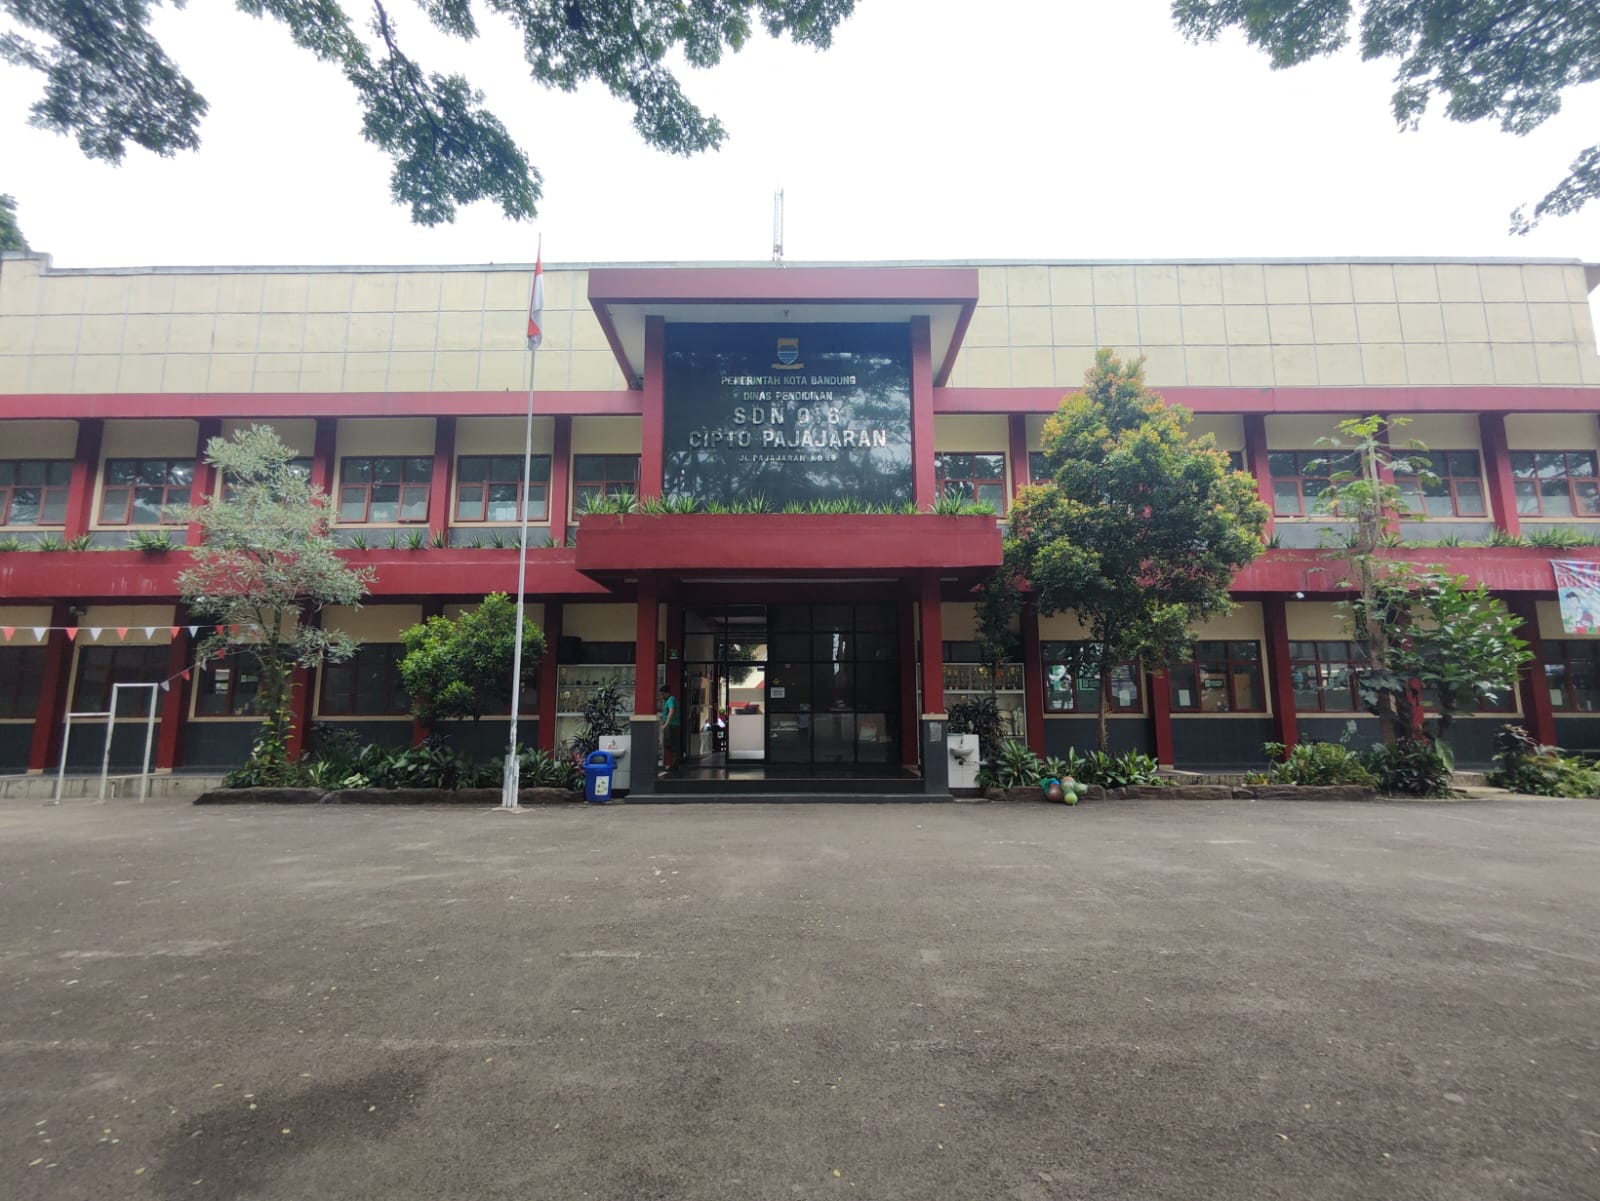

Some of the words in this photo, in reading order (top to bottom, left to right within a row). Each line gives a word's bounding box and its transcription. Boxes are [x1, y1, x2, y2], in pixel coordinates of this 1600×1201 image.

[721, 376, 780, 386] PEMERINTAH
[783, 376, 808, 385] KOTA
[811, 375, 856, 385] BANDUNG
[743, 391, 772, 401] DINAS
[775, 391, 833, 401] PENDIDIKAN
[734, 406, 784, 425] SDN
[689, 430, 751, 449] CIPTO
[763, 430, 886, 448] PAJAJARAN
[752, 454, 806, 462] PAJAJARAN
